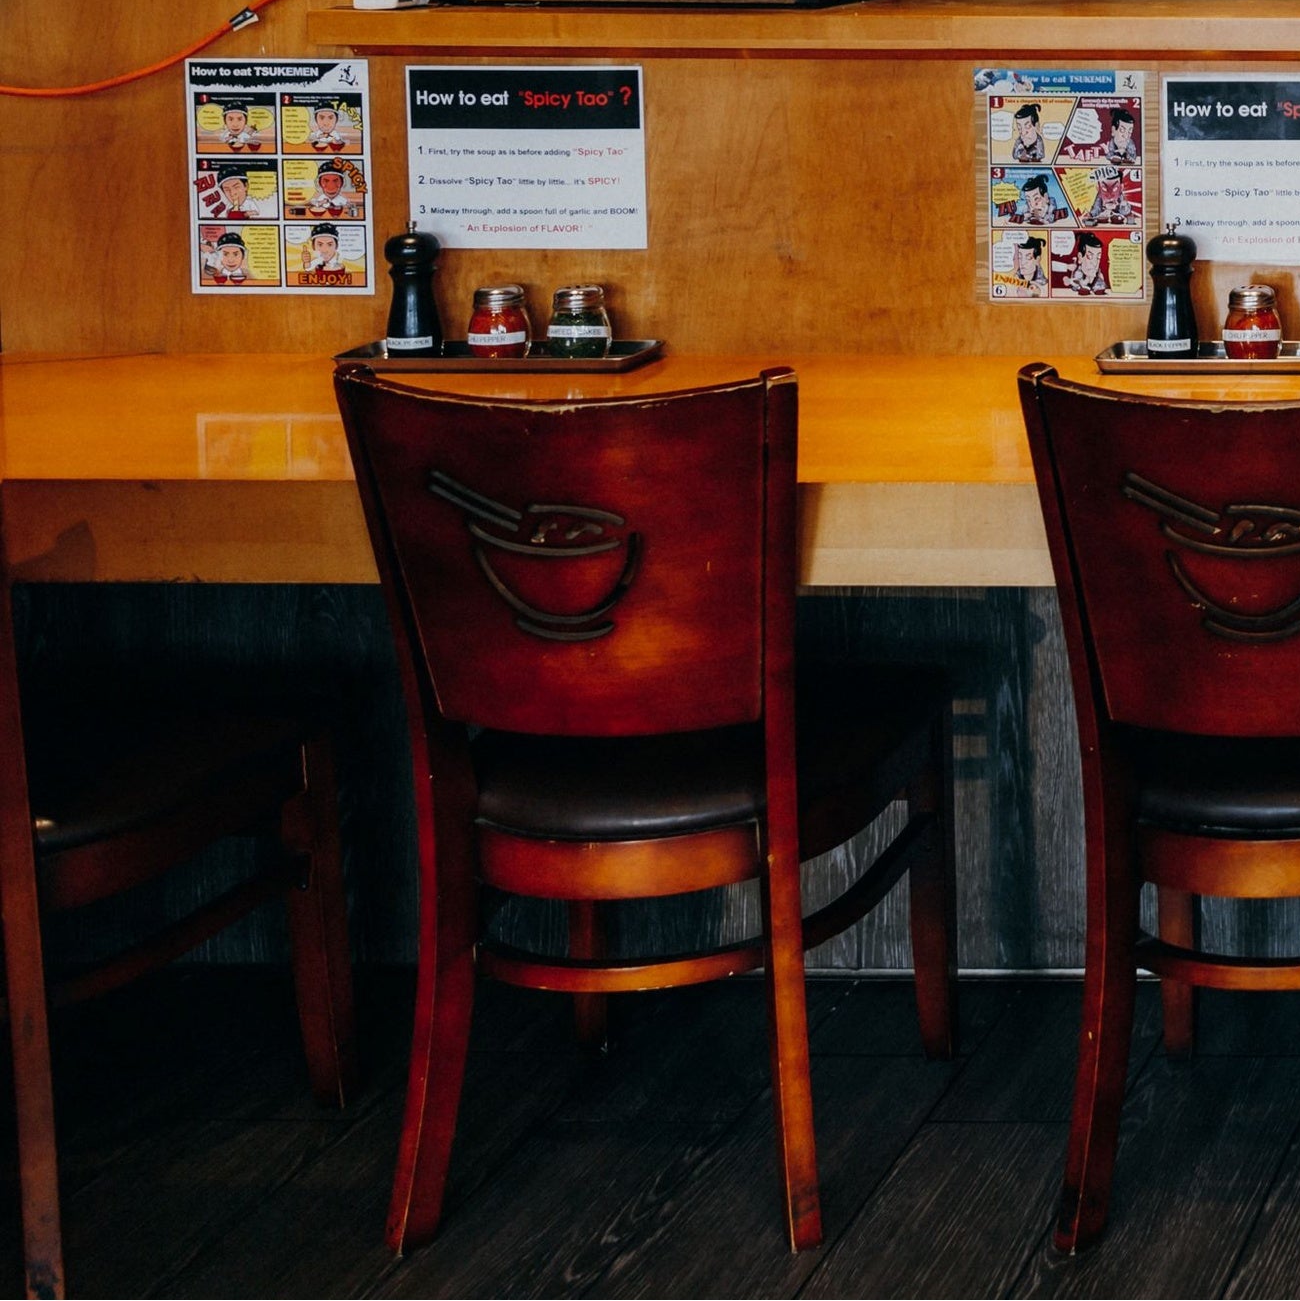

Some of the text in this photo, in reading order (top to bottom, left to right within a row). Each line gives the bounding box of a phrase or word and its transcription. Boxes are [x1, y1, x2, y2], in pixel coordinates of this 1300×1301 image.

[191, 66, 319, 77] How to eat TSUKEMEN
[1022, 75, 1038, 83] How
[1053, 75, 1067, 83] eat
[1070, 75, 1113, 84] TSUKEMEN
[416, 86, 632, 109] How to eat "Spicy Tao" ?
[993, 97, 1001, 107] 1
[1132, 98, 1140, 107] 2
[1173, 101, 1212, 117] How
[1216, 102, 1234, 117] to
[1238, 102, 1268, 117] eat
[330, 101, 363, 131] TASTY
[333, 157, 368, 195] SPICY
[993, 168, 1001, 178] 3
[1132, 169, 1139, 179] 4
[1133, 232, 1141, 241] 5
[298, 273, 352, 285] ENJOY!
[995, 286, 1003, 295] 6
